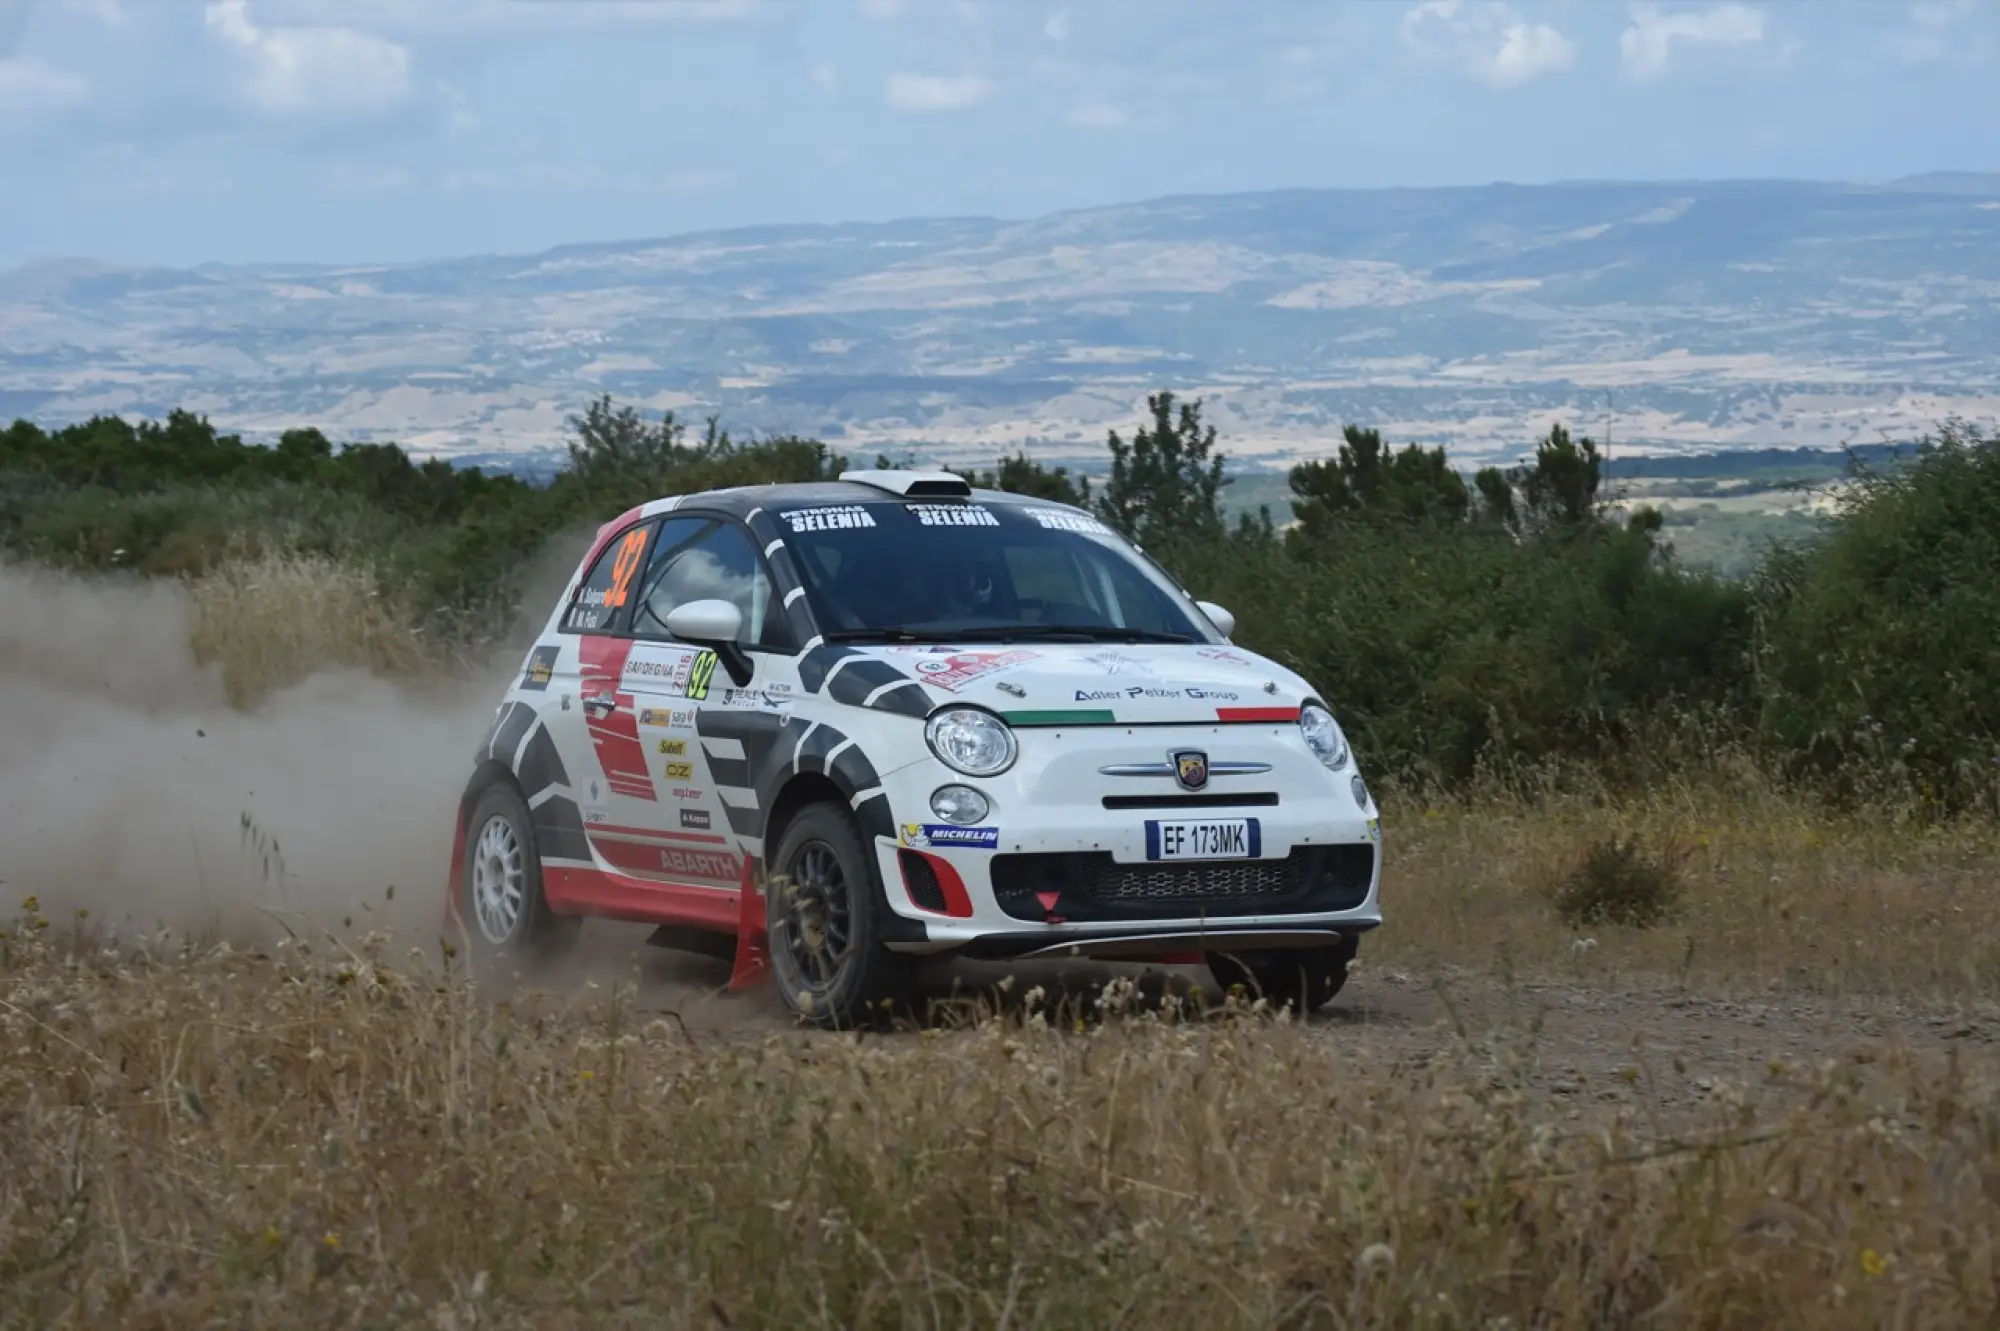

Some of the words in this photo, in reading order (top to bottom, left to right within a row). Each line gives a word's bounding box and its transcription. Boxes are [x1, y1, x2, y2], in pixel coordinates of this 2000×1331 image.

[791, 512, 877, 533] SELENIA
[918, 510, 1001, 526] SELENIA
[604, 530, 648, 608] 92
[688, 652, 717, 699] 92
[1075, 690, 1121, 701] Adler
[1185, 688, 1239, 701] Group
[666, 764, 690, 777] OZ
[931, 829, 998, 841] MICHELIN
[1164, 826, 1185, 854] EF
[1191, 824, 1245, 854] 173MK
[661, 850, 737, 877] ABARTH
